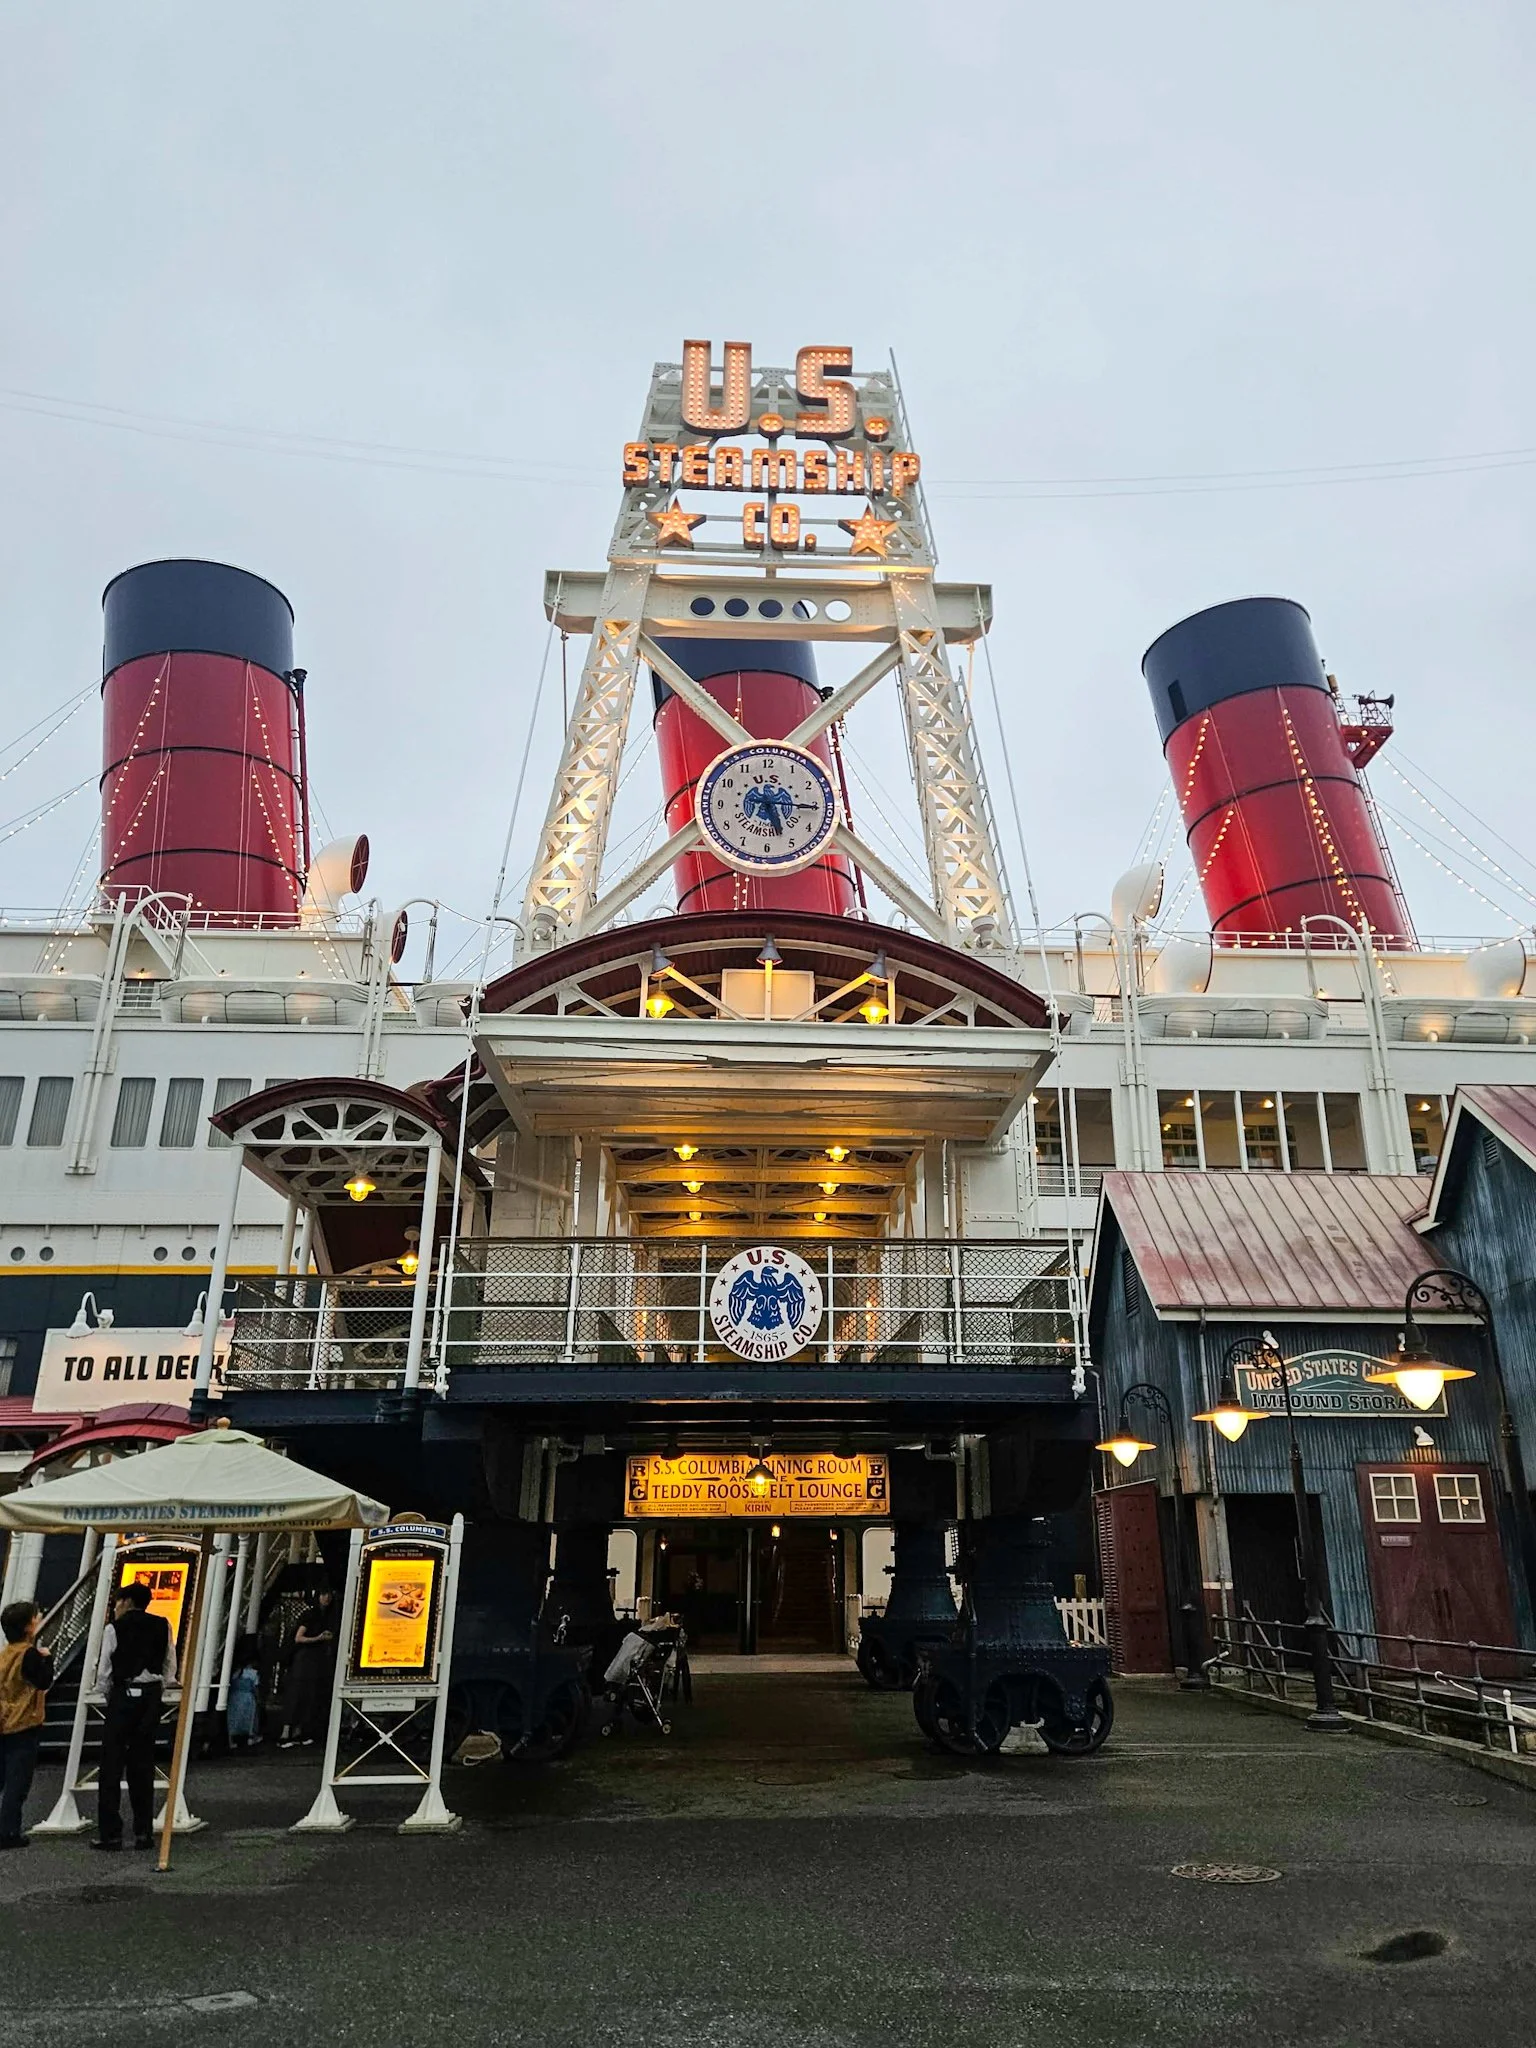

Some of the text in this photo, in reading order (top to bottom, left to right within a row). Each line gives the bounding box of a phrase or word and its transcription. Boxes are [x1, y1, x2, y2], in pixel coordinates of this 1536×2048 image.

[682, 340, 890, 441] U.S.
[623, 442, 920, 497] STEAMSHIP
[743, 502, 816, 551] CO.
[723, 747, 807, 767] S.S. COLUMBIA
[762, 759, 774, 769] 12
[740, 764, 750, 773] 11
[790, 765, 795, 774] 1
[721, 779, 734, 788] 10
[753, 774, 782, 786] U.S.
[805, 780, 812, 790] 2
[717, 799, 724, 810] 9
[702, 781, 740, 857] MONONGAHELA
[723, 820, 730, 831] 8
[734, 812, 801, 838] STEAMSHI CO.
[792, 802, 834, 860] HOUSATONIC
[805, 822, 812, 833] 4
[739, 836, 746, 847] 7
[764, 843, 770, 853] 6
[788, 838, 795, 848] 5
[746, 1249, 790, 1269] U.S.
[714, 1314, 817, 1360] STEAMSHIP CO.
[749, 1330, 779, 1343] 1865
[64, 1356, 95, 1382] TO
[103, 1355, 149, 1381] ALL
[1303, 1358, 1358, 1380] STATES
[1251, 1391, 1433, 1411] IMPOUND STORA
[653, 1460, 675, 1475] S.S.
[678, 1460, 754, 1475] COLUMBIA
[817, 1459, 862, 1474] ROOM
[869, 1464, 883, 1476] B
[632, 1485, 645, 1499] C
[652, 1484, 702, 1499] TEDDY
[799, 1484, 862, 1499] LOUNGE
[870, 1484, 883, 1498] C
[63, 1506, 119, 1520] UNITED
[121, 1505, 176, 1520] STATES
[179, 1504, 263, 1520] STEAMSHIP
[744, 1503, 772, 1513] KIRIN
[378, 1525, 437, 1535] S.S. COLUMBIA
